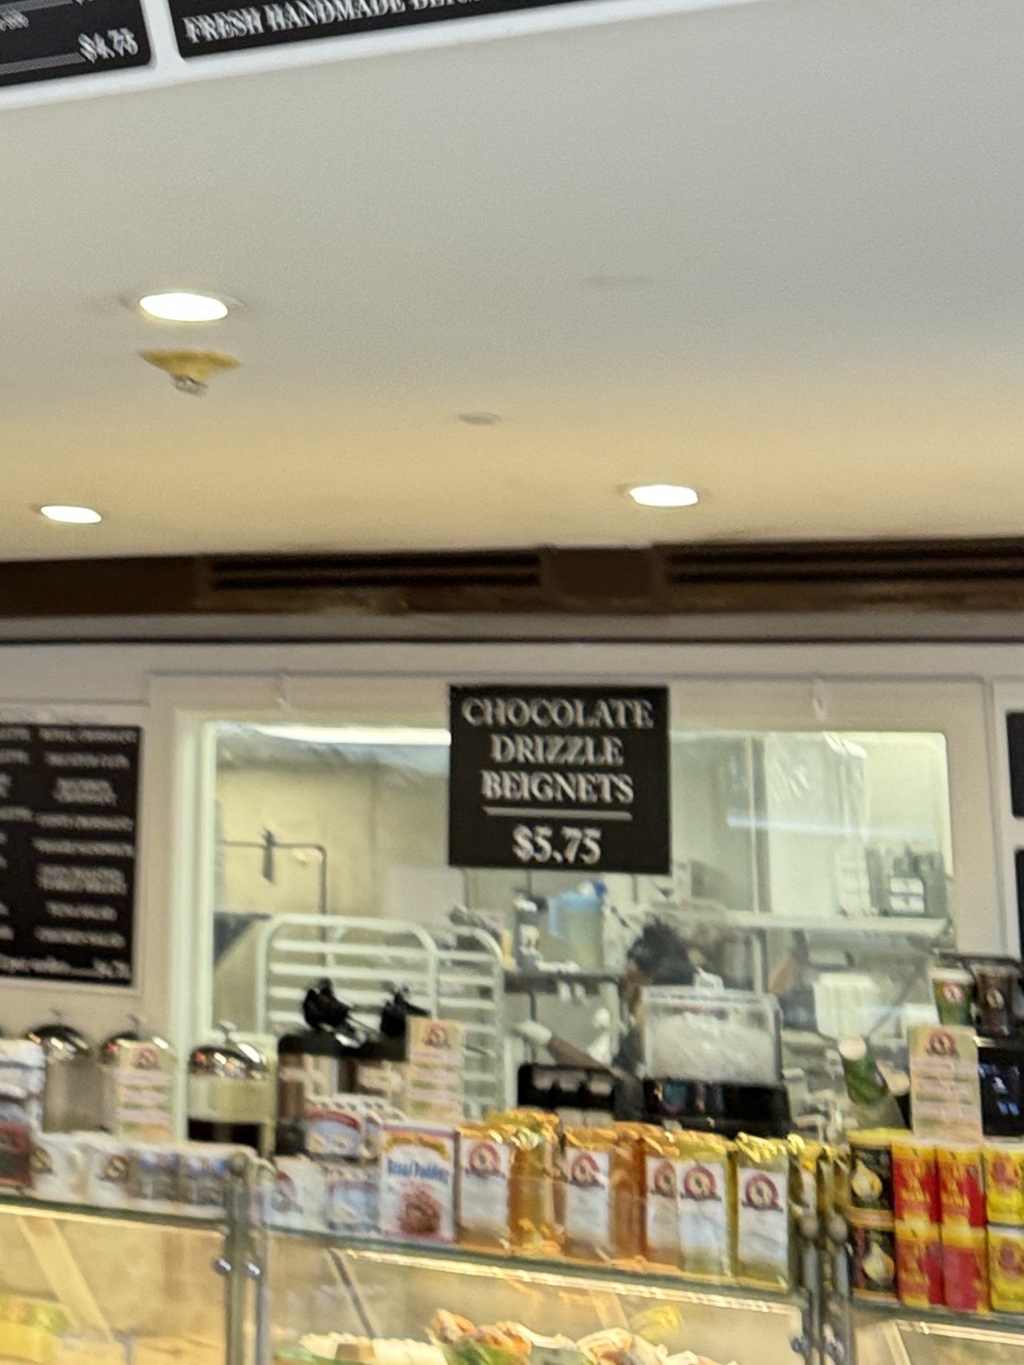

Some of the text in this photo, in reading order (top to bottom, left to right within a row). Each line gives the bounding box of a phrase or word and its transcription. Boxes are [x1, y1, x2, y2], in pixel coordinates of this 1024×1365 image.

[181, 5, 265, 44] FRESH
[461, 697, 655, 729] CHOCOLATE
[490, 733, 625, 767] DRIZZLE
[480, 769, 635, 804] BEIGNETS
[512, 823, 603, 864] $5.75
